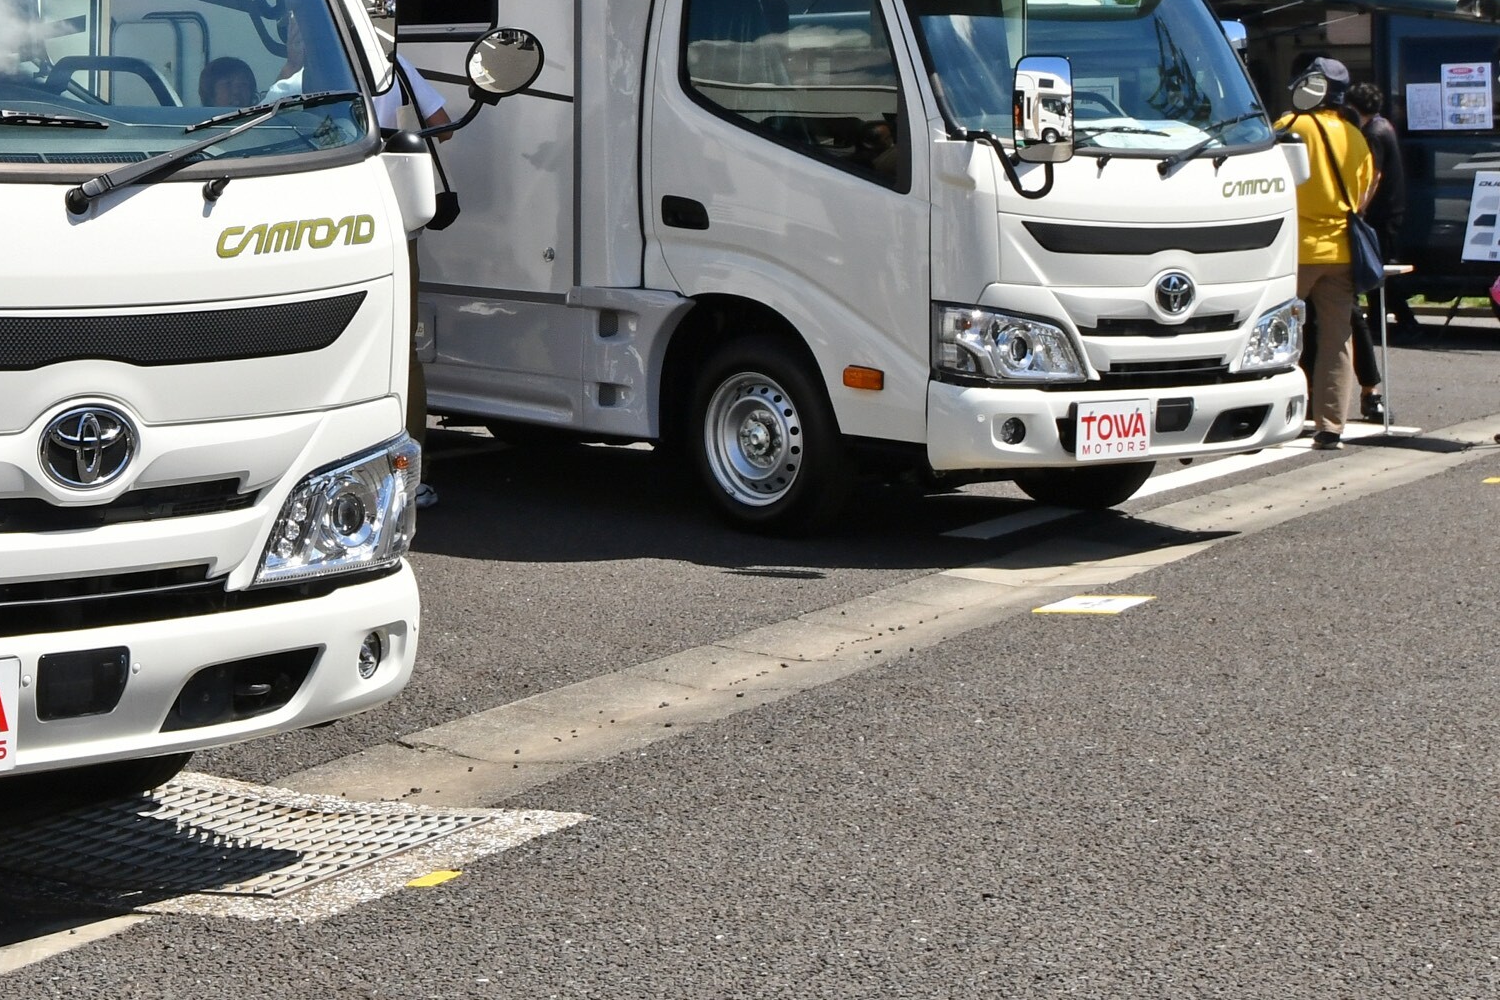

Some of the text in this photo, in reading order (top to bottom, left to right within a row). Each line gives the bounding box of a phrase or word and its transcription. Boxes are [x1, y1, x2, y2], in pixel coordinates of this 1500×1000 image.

[1222, 177, 1285, 198] CAMROAD
[216, 214, 375, 259] CAMROAD
[1081, 412, 1146, 441] TOWA
[1082, 440, 1146, 455] MOTORS
